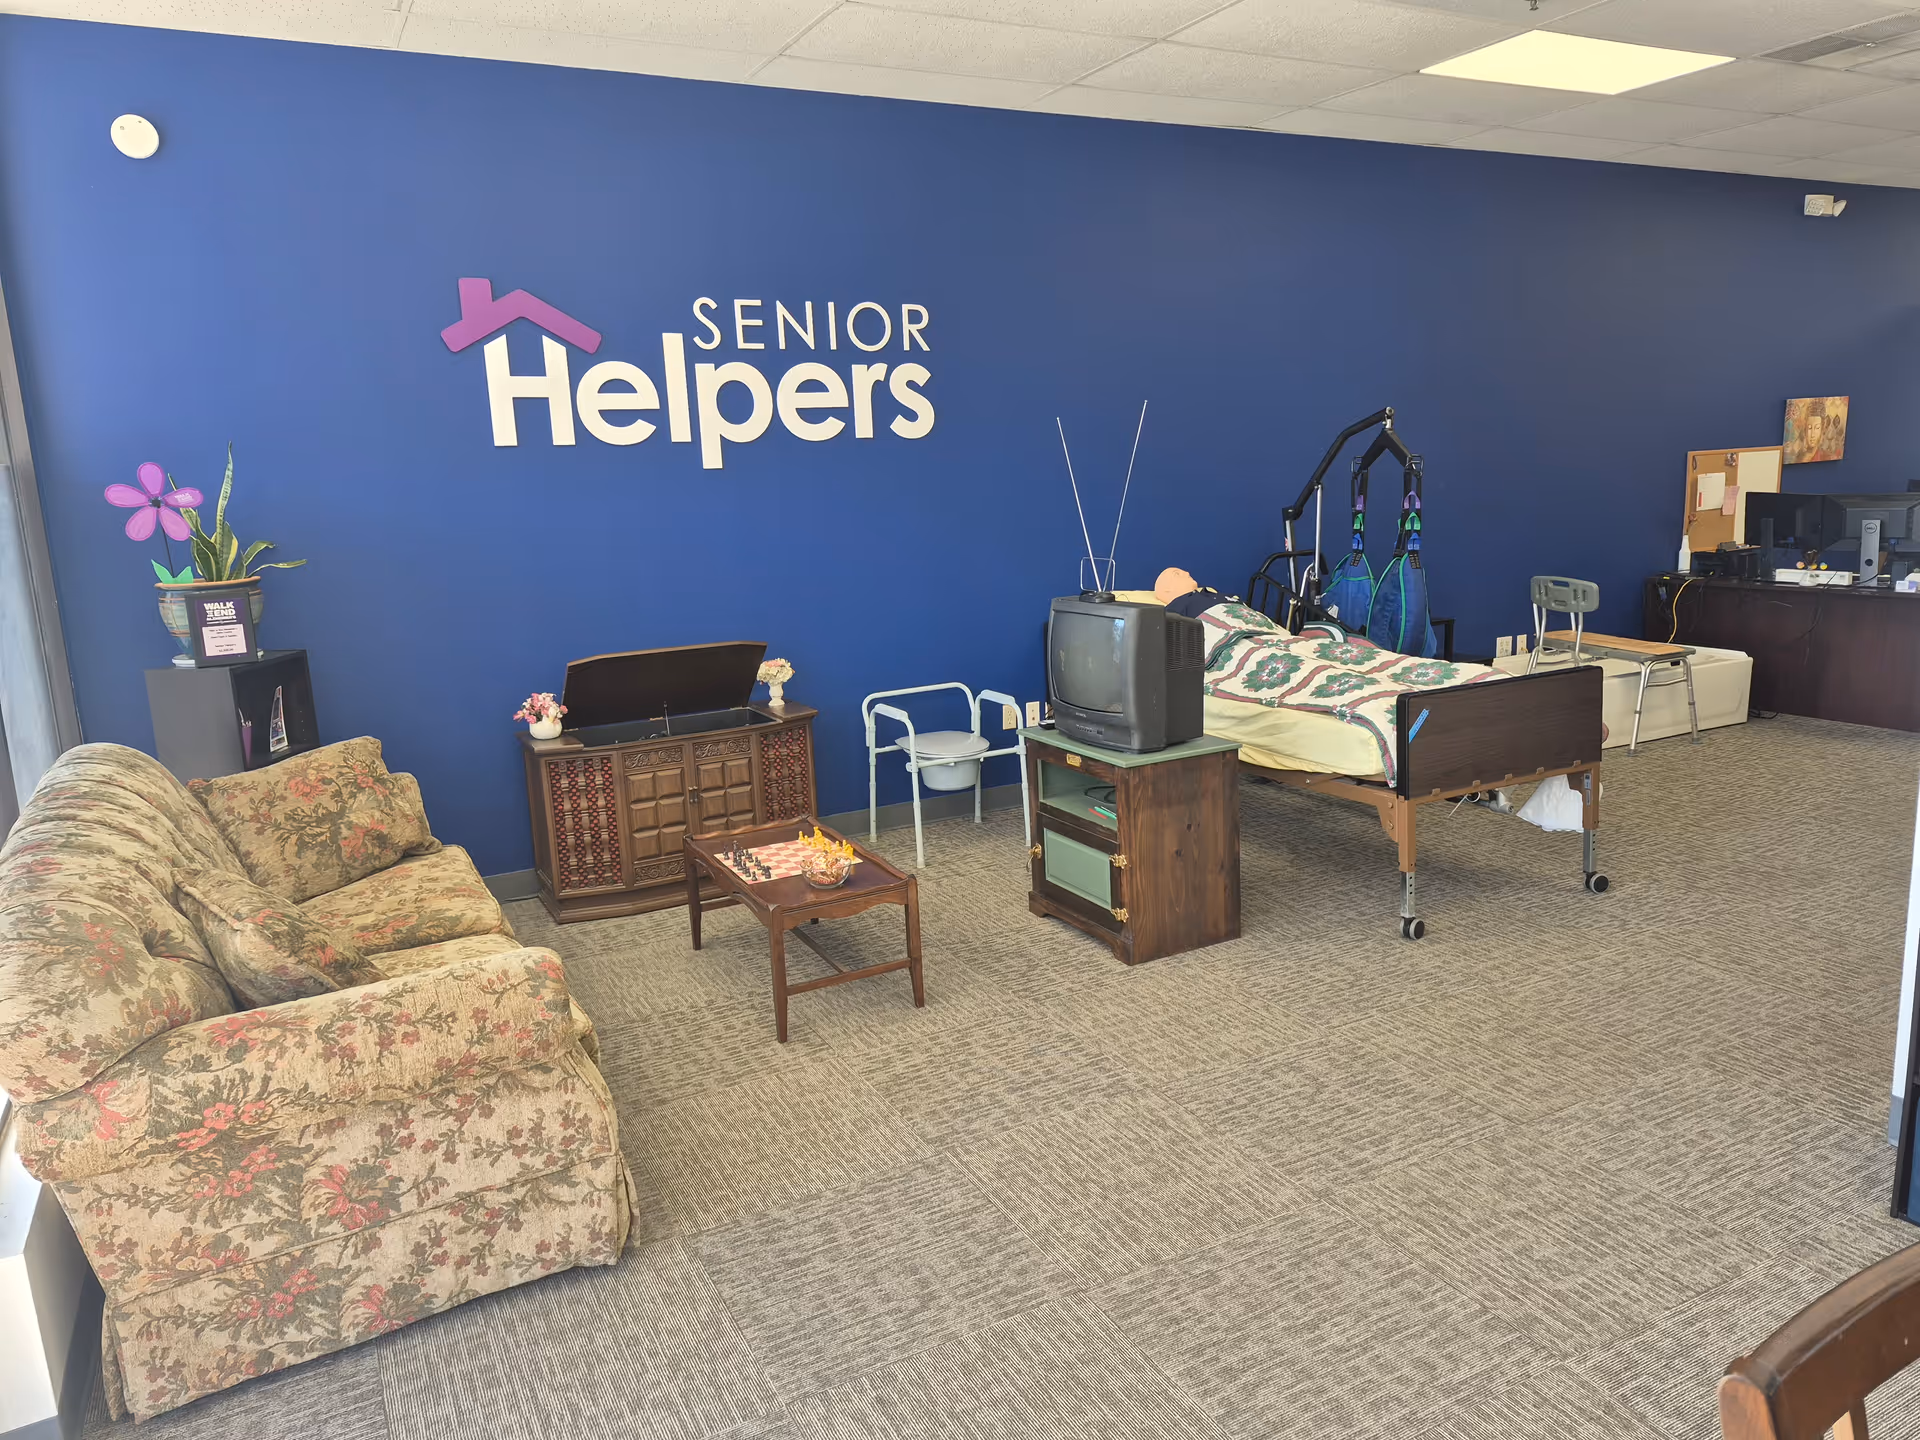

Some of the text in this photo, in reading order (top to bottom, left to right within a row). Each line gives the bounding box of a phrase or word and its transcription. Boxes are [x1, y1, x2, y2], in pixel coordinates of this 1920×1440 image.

[692, 296, 931, 352] SENIOR
[483, 332, 936, 470] Helpers
[203, 601, 235, 610] WALK
[214, 609, 236, 617] END
